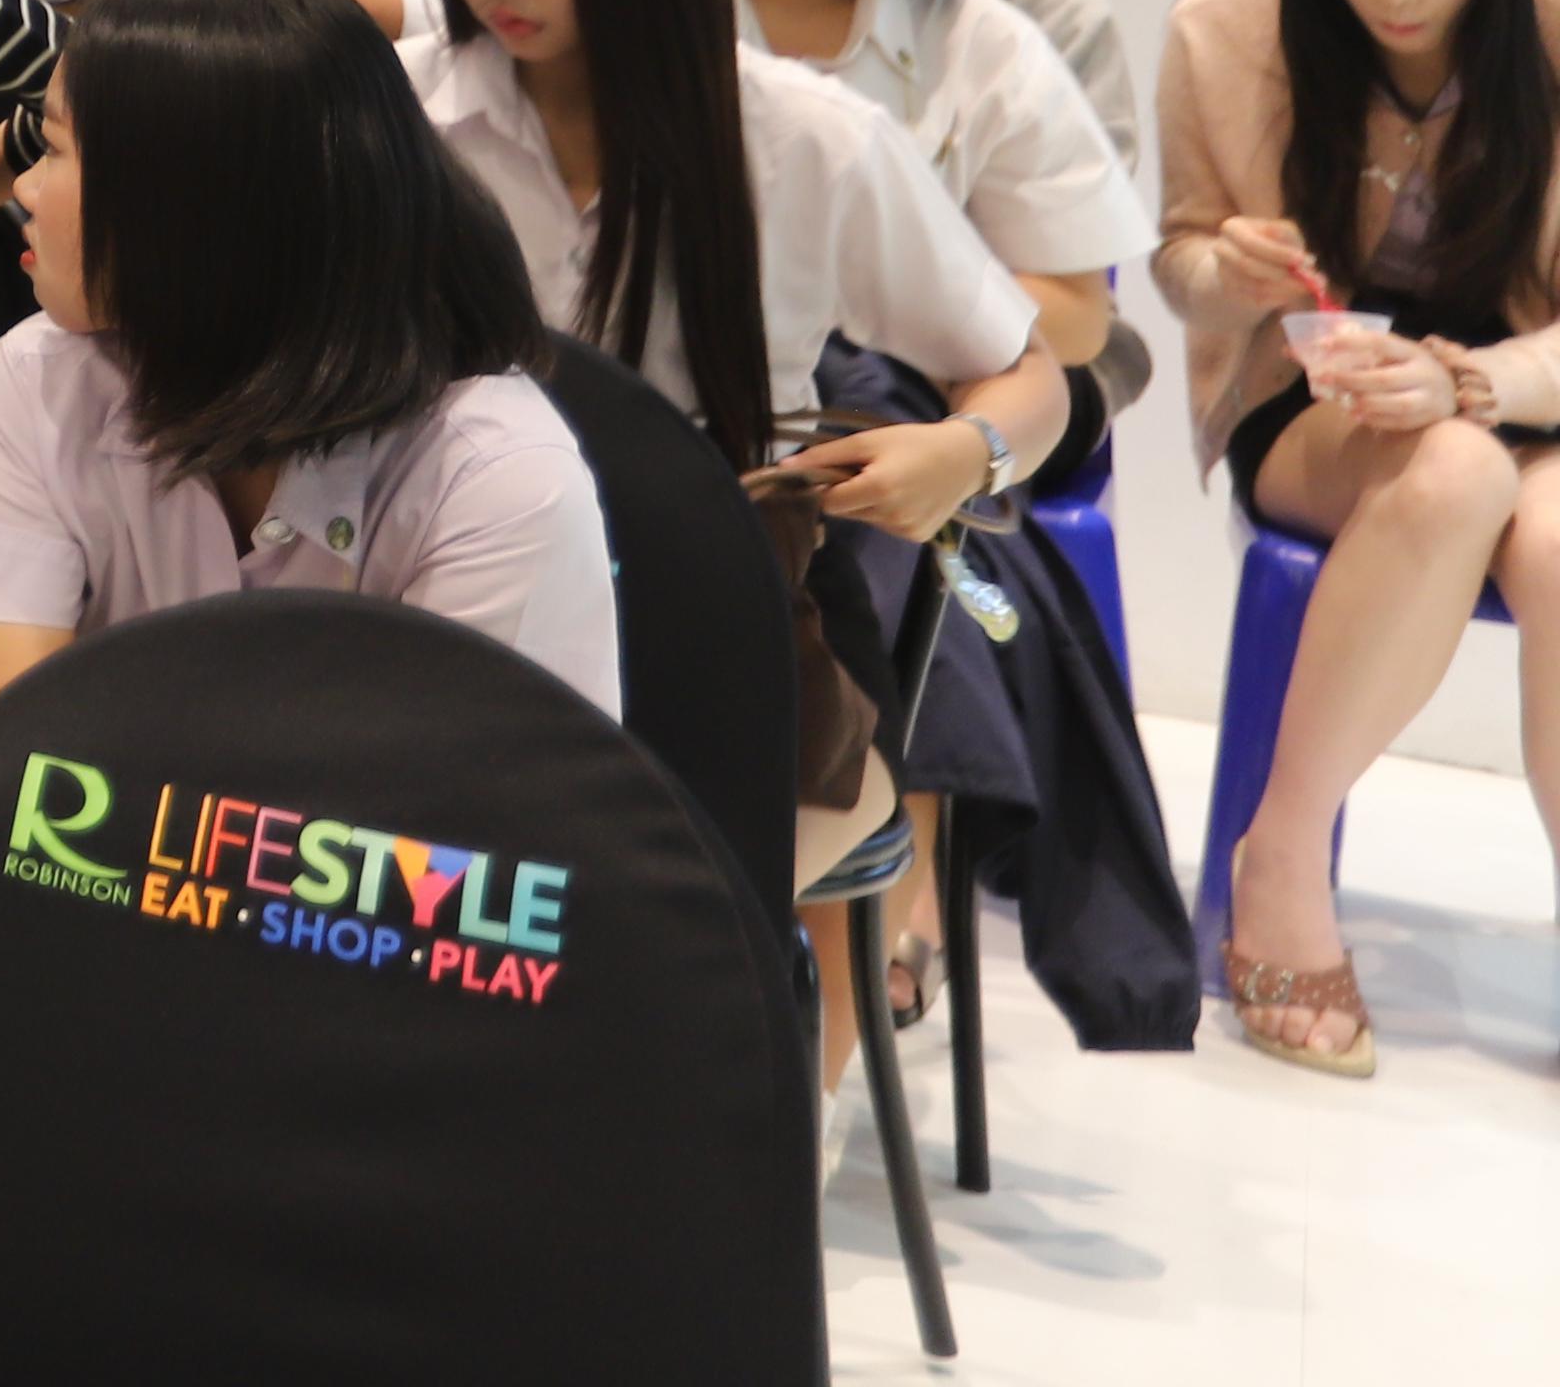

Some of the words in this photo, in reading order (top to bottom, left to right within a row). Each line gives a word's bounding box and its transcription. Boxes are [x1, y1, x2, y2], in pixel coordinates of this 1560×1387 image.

[3, 853, 131, 907] ROBINSON
[140, 872, 230, 930] EAT
[260, 901, 401, 968] SHOP
[429, 938, 560, 1005] PLAY
[9, 751, 128, 879] R
[147, 782, 569, 954] LIFESTYLE
